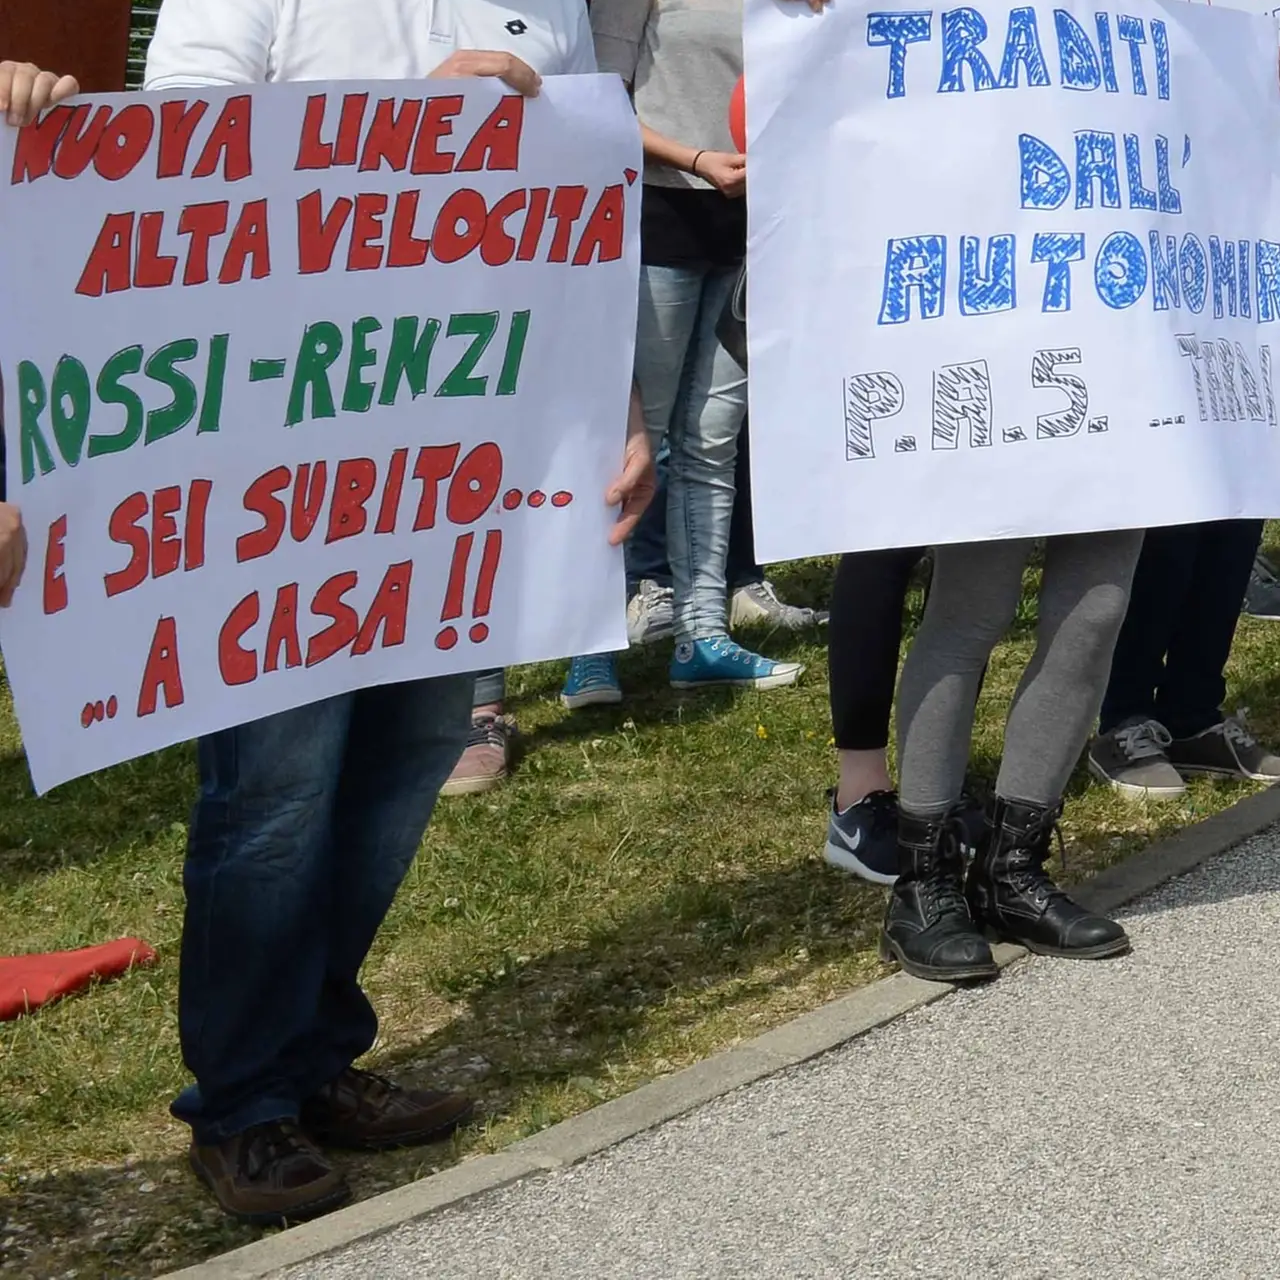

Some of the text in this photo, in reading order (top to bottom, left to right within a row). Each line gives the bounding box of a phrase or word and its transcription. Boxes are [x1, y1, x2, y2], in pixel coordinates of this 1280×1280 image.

[867, 5, 1170, 100] TRADITI
[11, 92, 525, 186] NUOVA LINEA
[75, 196, 271, 296] ALTA
[843, 346, 1109, 461] P.A.S.
[42, 513, 69, 616] E
[103, 478, 213, 598] SEI
[217, 559, 414, 687] CASA
